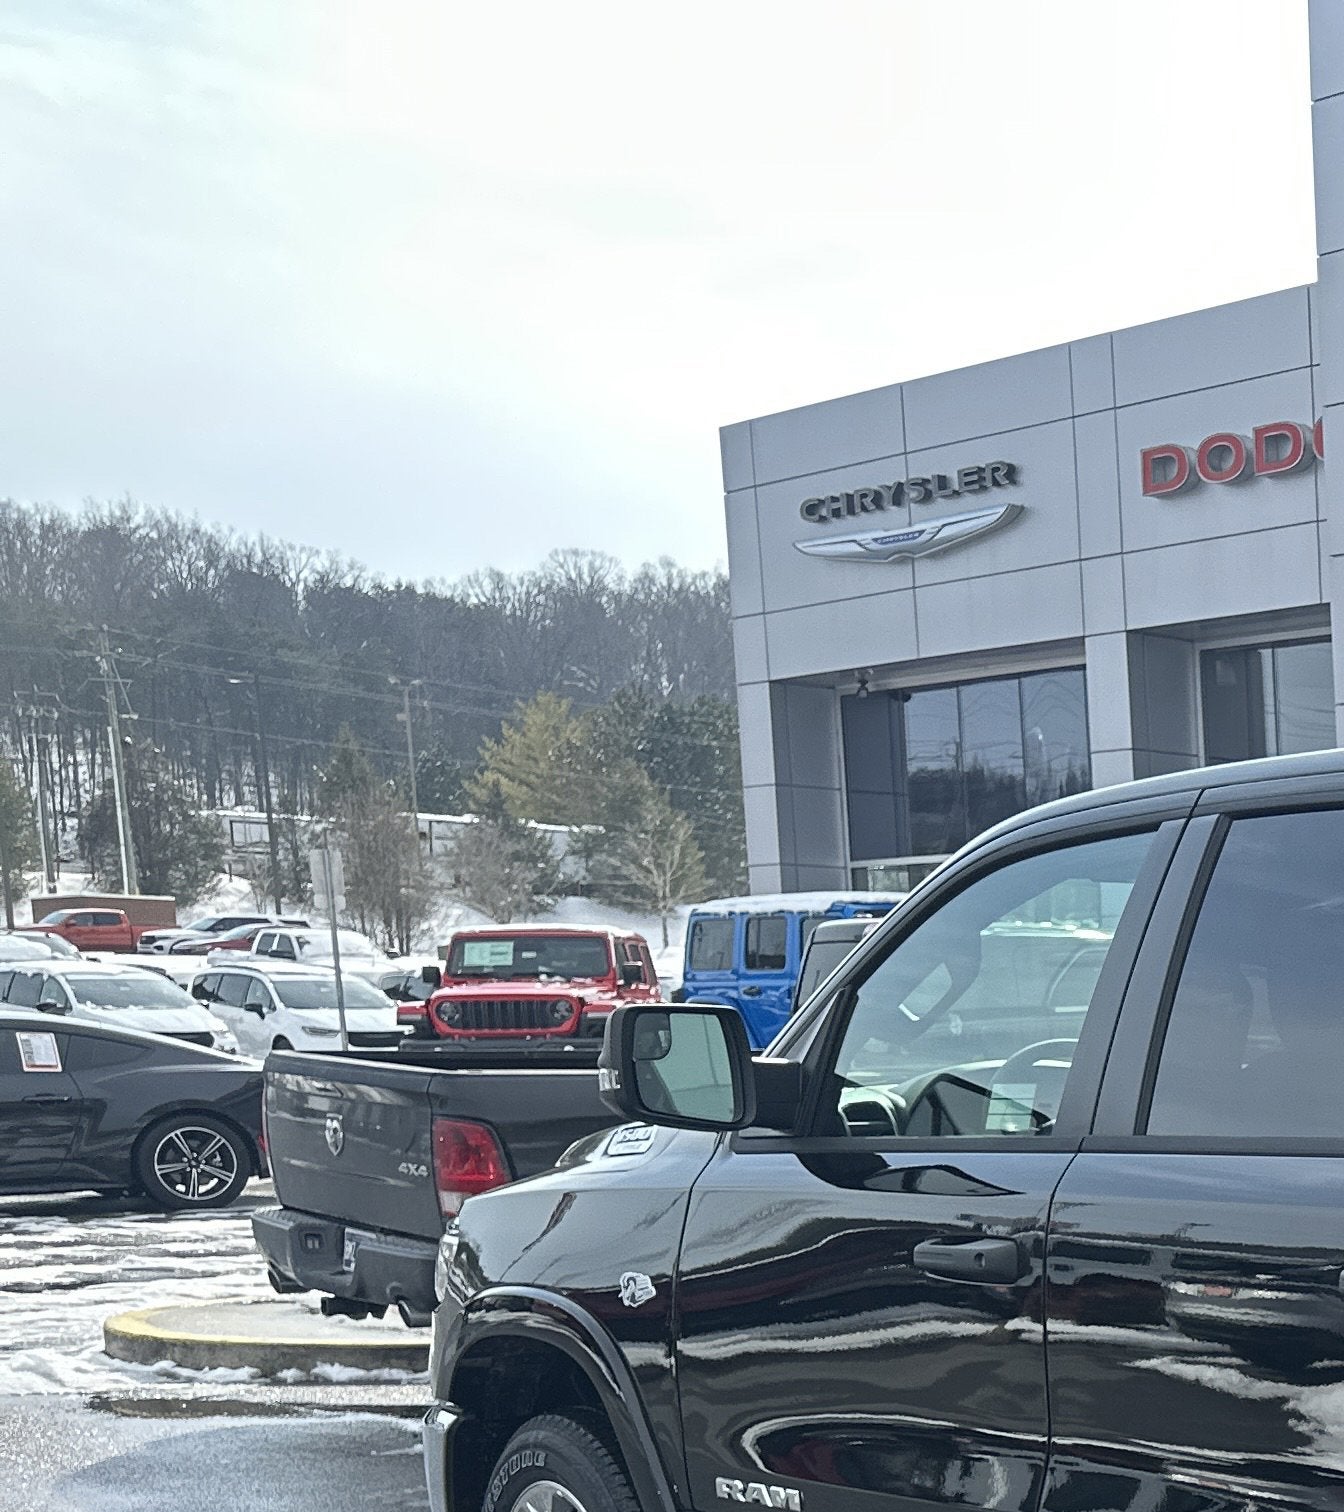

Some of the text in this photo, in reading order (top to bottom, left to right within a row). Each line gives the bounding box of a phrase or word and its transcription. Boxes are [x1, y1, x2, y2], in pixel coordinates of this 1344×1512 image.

[1141, 418, 1324, 497] DOD
[800, 460, 1018, 523] CHRYSLER
[715, 1477, 804, 1512] RAM
